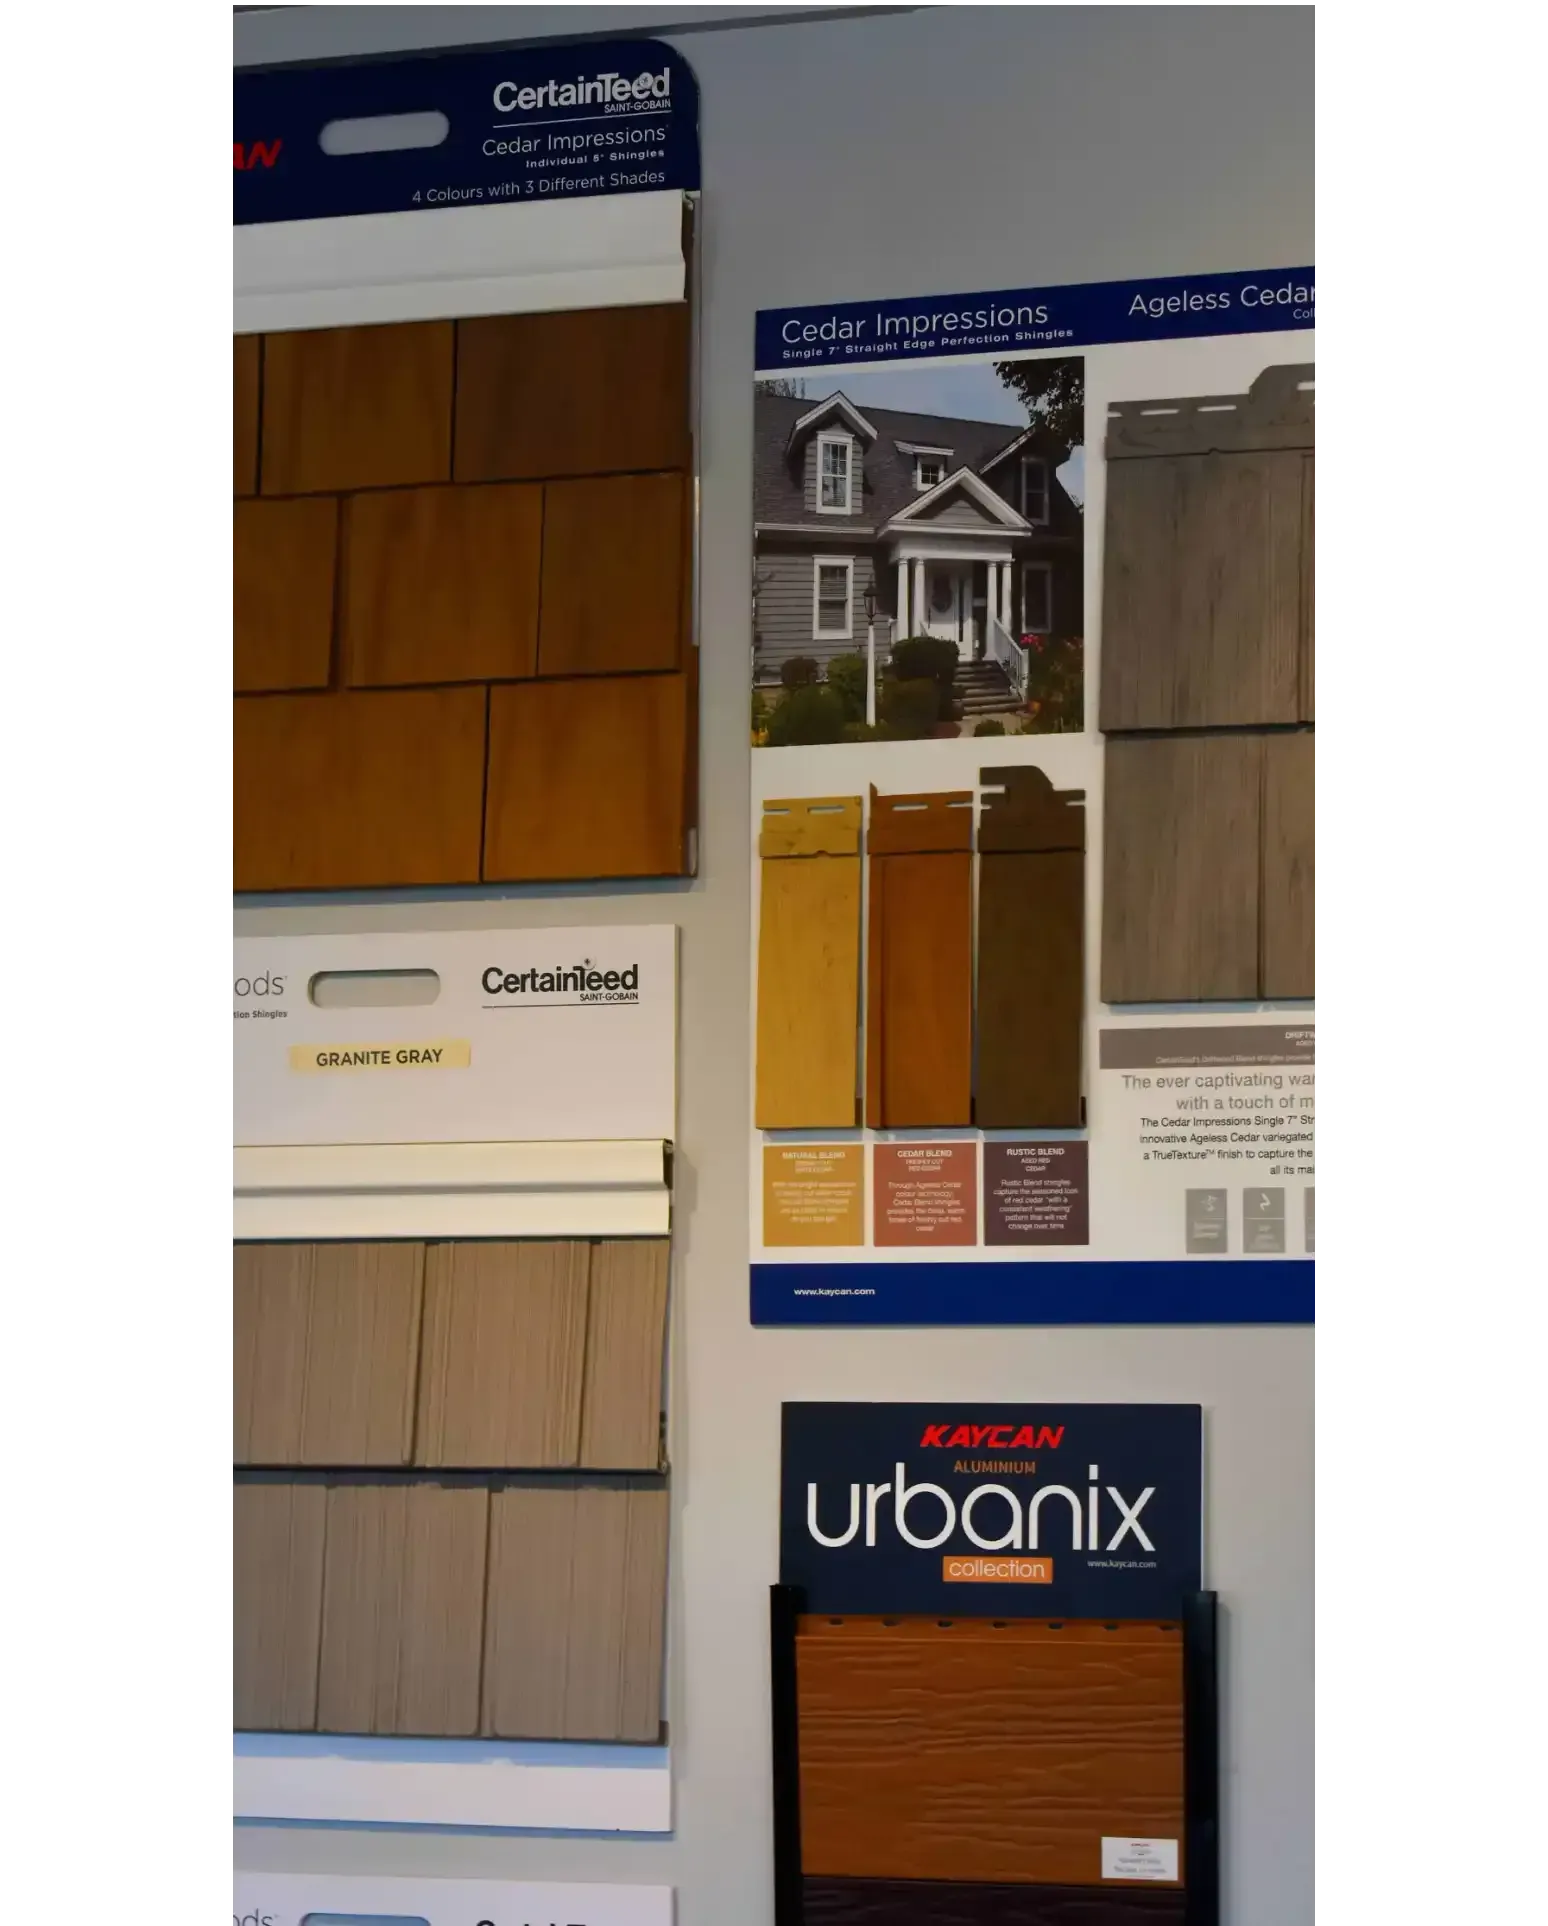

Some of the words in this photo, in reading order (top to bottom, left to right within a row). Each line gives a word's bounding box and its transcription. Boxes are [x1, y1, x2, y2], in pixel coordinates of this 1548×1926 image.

[493, 67, 671, 112] CertainTeed
[604, 99, 671, 113] SAINT-GOBAIN
[482, 136, 541, 157] Cedar
[548, 126, 666, 152] Impressions
[525, 155, 588, 169] Individual
[609, 149, 665, 161] Shingles
[412, 190, 421, 203] 4
[426, 186, 484, 202] Colours
[488, 181, 520, 196] with
[525, 180, 535, 194] 3
[539, 174, 605, 192] Different
[610, 170, 666, 187] Shades
[1128, 289, 1231, 318] Ageless
[782, 315, 866, 344] Cedar
[876, 304, 1048, 338] Impressions
[782, 347, 823, 359] Single
[845, 342, 898, 354] Straight
[903, 339, 936, 350] Edge
[941, 333, 1010, 347] Perfection
[1015, 328, 1074, 341] Shingles
[482, 963, 639, 995] CertainTeed
[580, 992, 639, 1002] SAINT-GOBAIN
[252, 1009, 288, 1020] Shingles
[316, 1050, 391, 1067] GRANITE
[396, 1048, 443, 1064] GRAY
[1121, 1074, 1152, 1089] The
[1156, 1076, 1190, 1088] ever
[1195, 1072, 1283, 1090] captivating
[1176, 1095, 1209, 1110] with
[1214, 1098, 1224, 1109] a
[1229, 1095, 1273, 1109] touch
[1279, 1095, 1296, 1108] of
[1140, 1117, 1159, 1128] The
[1161, 1117, 1190, 1127] Cedar
[1193, 1116, 1251, 1128] Impressions
[1254, 1115, 1284, 1127] Single
[1190, 1133, 1228, 1145] Ageless
[1230, 1132, 1259, 1142] Cedar
[1262, 1132, 1314, 1144] variegated
[926, 1149, 953, 1157] BLEND
[1006, 1148, 1036, 1156] RUSTIC
[1038, 1147, 1065, 1155] BLEND
[1143, 1152, 1150, 1160] a
[1217, 1149, 1243, 1159] finish
[1245, 1149, 1256, 1159] to
[1258, 1150, 1295, 1161] capture
[1297, 1149, 1314, 1158] the
[1270, 1165, 1280, 1175] all
[1283, 1165, 1294, 1175] its
[794, 1288, 876, 1297] www.kaycan.com
[919, 1423, 1066, 1449] KAYCAN
[953, 1459, 1036, 1474] ALUMINIUM
[806, 1462, 1157, 1551] urbanix
[948, 1558, 1046, 1579] collection
